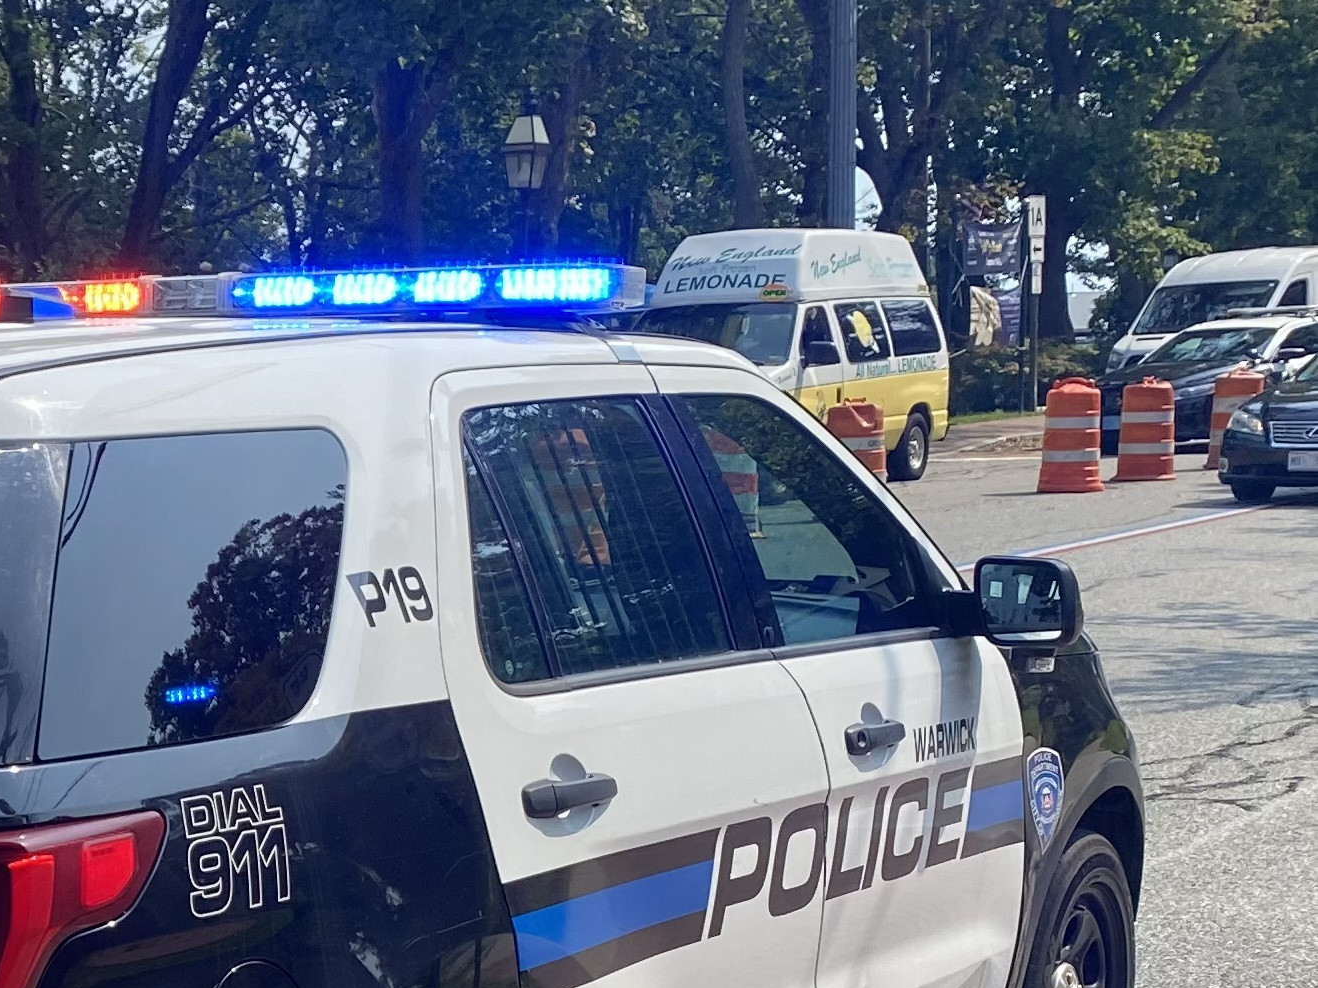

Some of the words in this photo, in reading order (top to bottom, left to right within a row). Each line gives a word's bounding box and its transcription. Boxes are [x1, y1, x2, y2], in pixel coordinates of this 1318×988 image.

[1032, 207, 1043, 227] 1A
[668, 256, 711, 271] New
[715, 244, 802, 264] England
[811, 260, 829, 279] New
[830, 246, 862, 274] England
[664, 274, 787, 294] LEMONADE
[898, 355, 937, 373] LEMONADE
[346, 566, 434, 627] P19
[913, 717, 976, 763] WARWICK
[180, 784, 285, 839] DIAL
[187, 824, 291, 918] 911
[708, 767, 971, 939] POLICE
